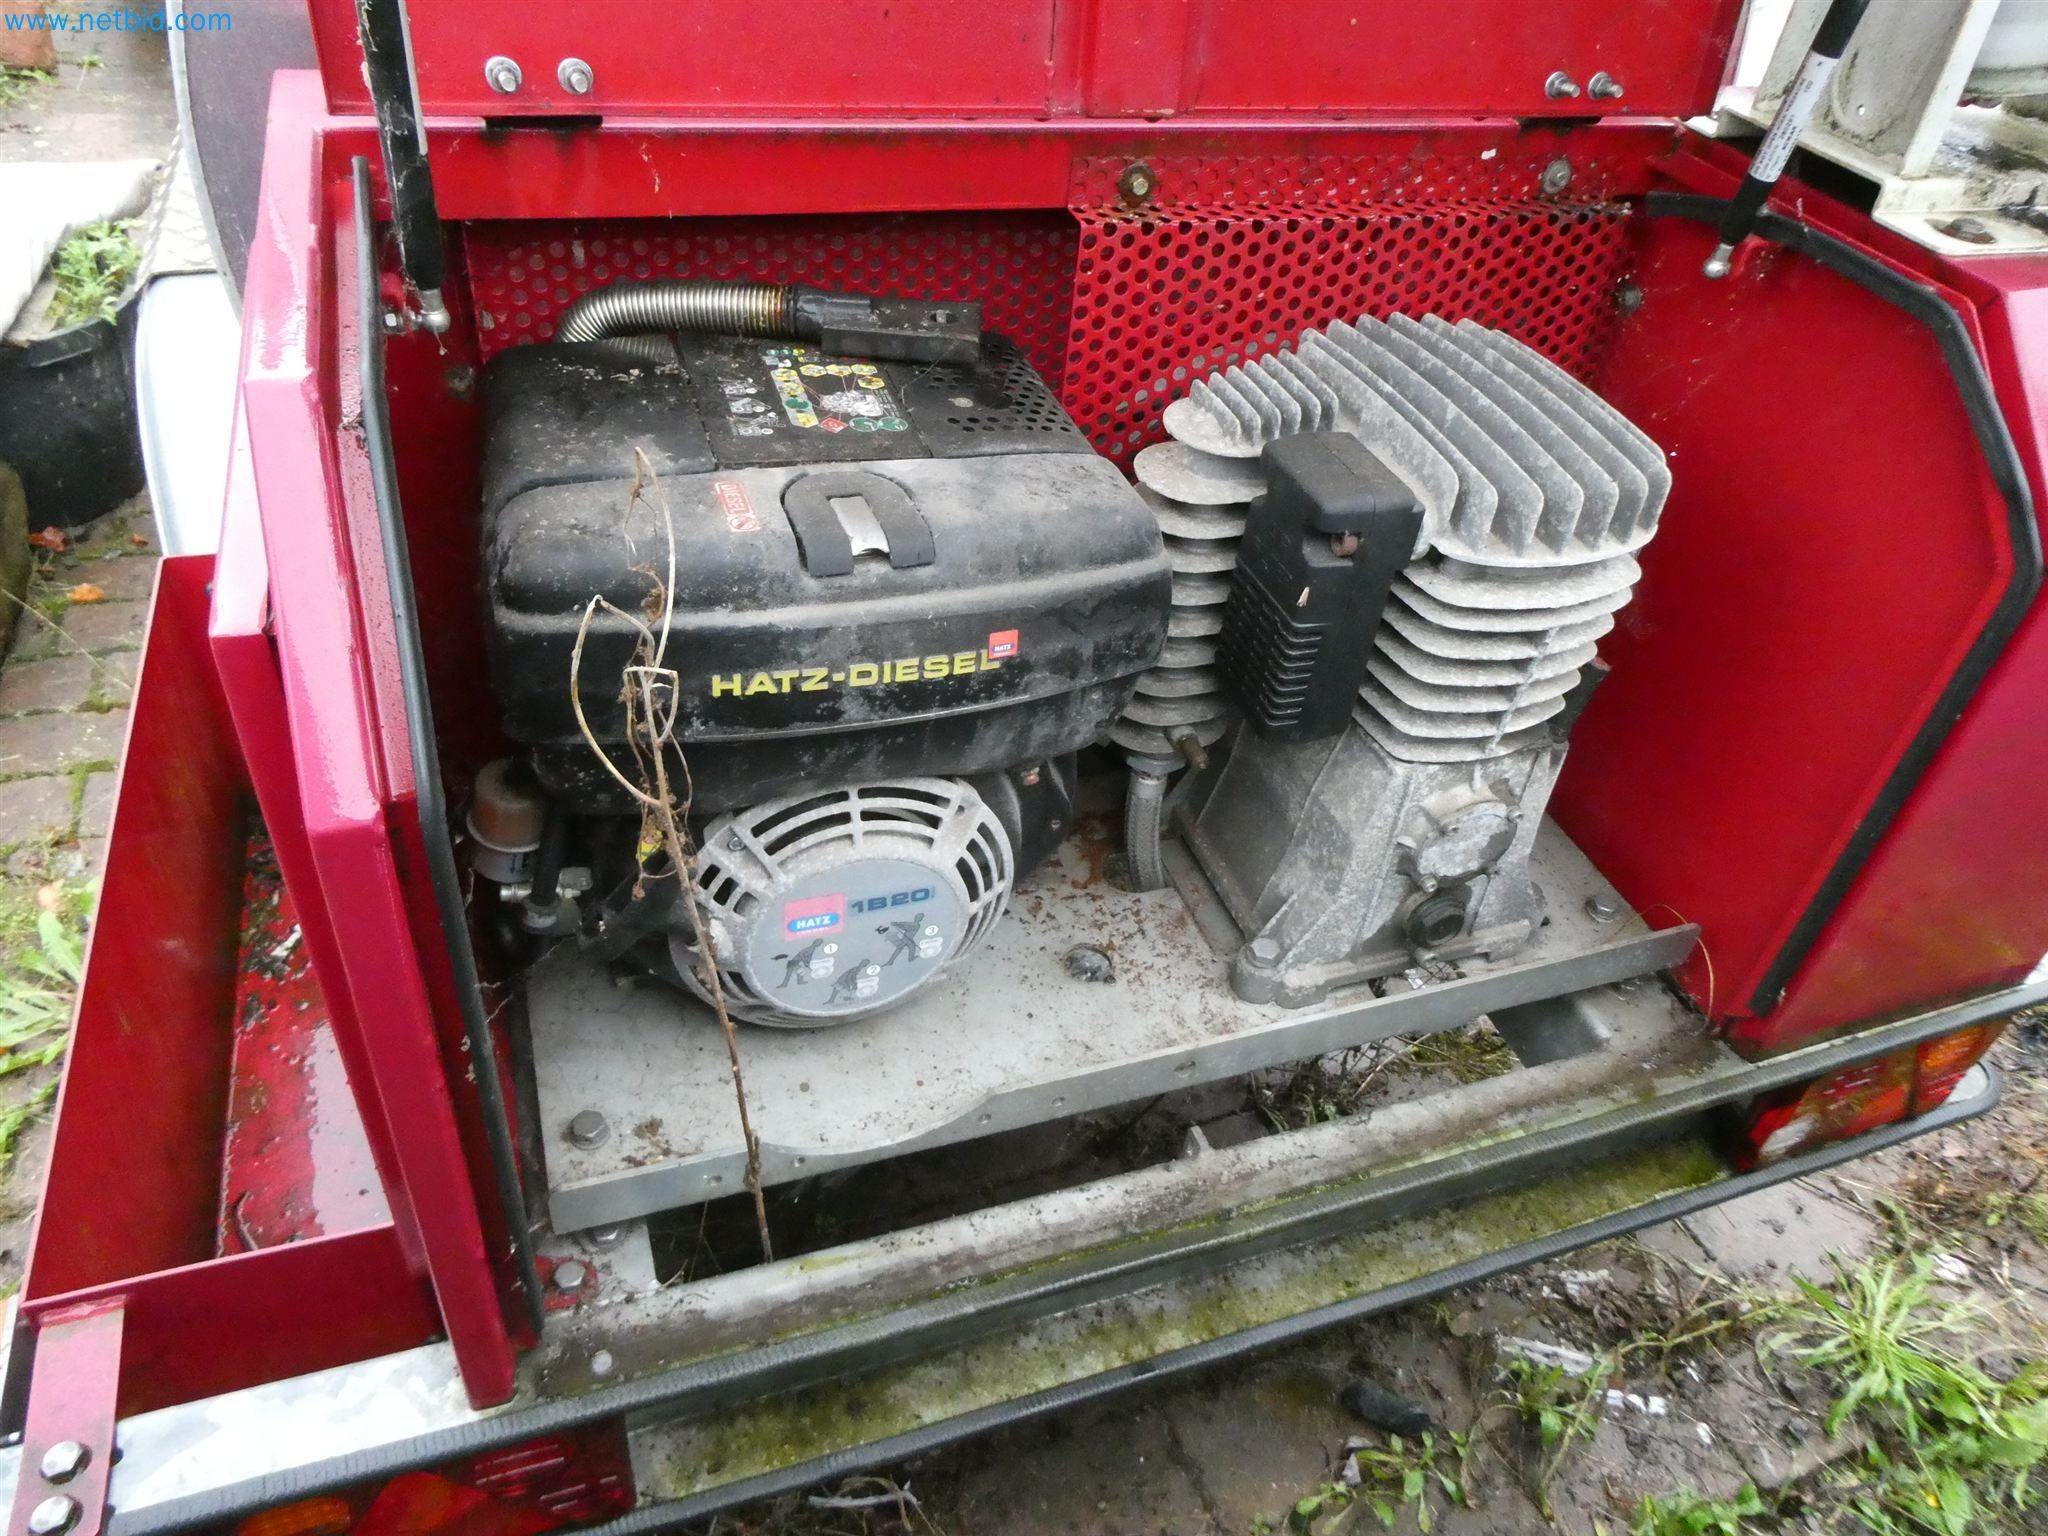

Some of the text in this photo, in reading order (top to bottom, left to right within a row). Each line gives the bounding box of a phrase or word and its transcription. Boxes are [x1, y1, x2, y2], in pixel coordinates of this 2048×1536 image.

[719, 483, 747, 515] DIESEL
[711, 650, 1000, 698] HATZ-DIESEL
[851, 888, 930, 913] 1B20
[796, 915, 832, 930] HATZ
